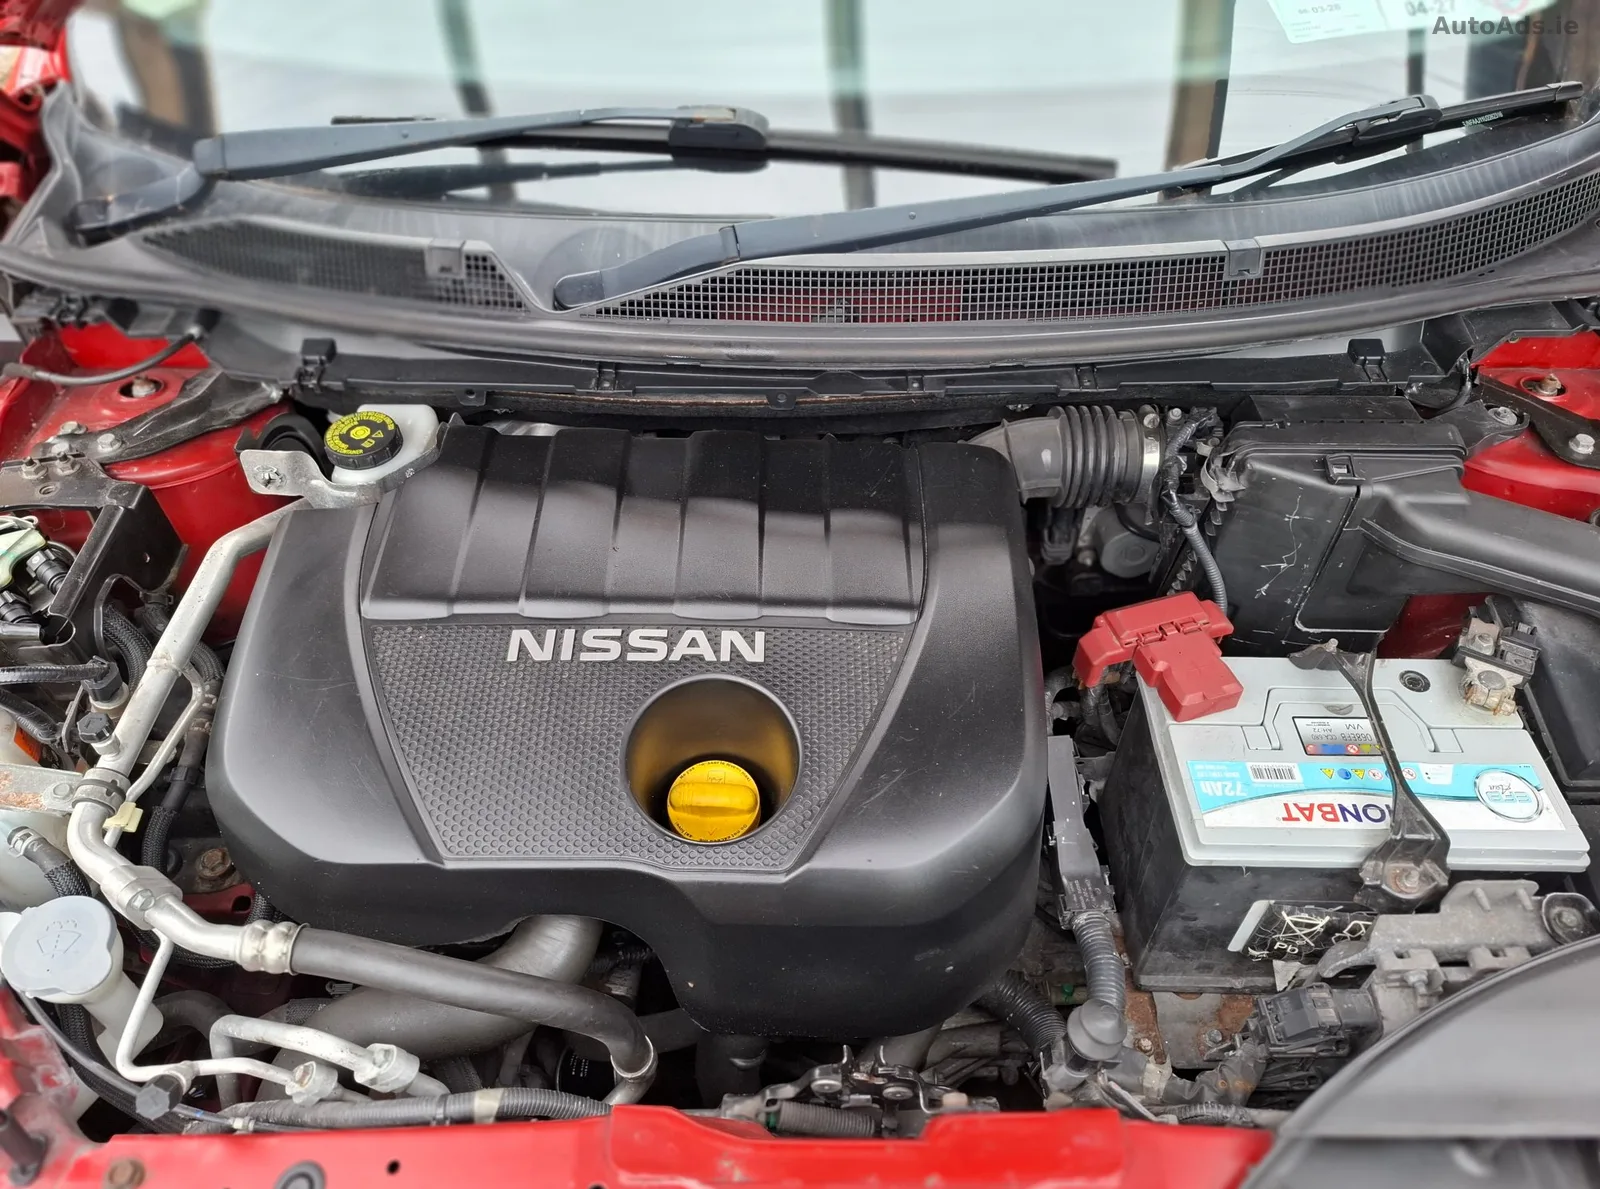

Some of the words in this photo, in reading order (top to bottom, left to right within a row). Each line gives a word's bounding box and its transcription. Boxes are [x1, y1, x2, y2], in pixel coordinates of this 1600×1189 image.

[507, 628, 765, 662] NISSAN
[1200, 780, 1247, 797] 72Ah
[1281, 801, 1392, 824] ONBAT
[1273, 942, 1299, 955] Pb
